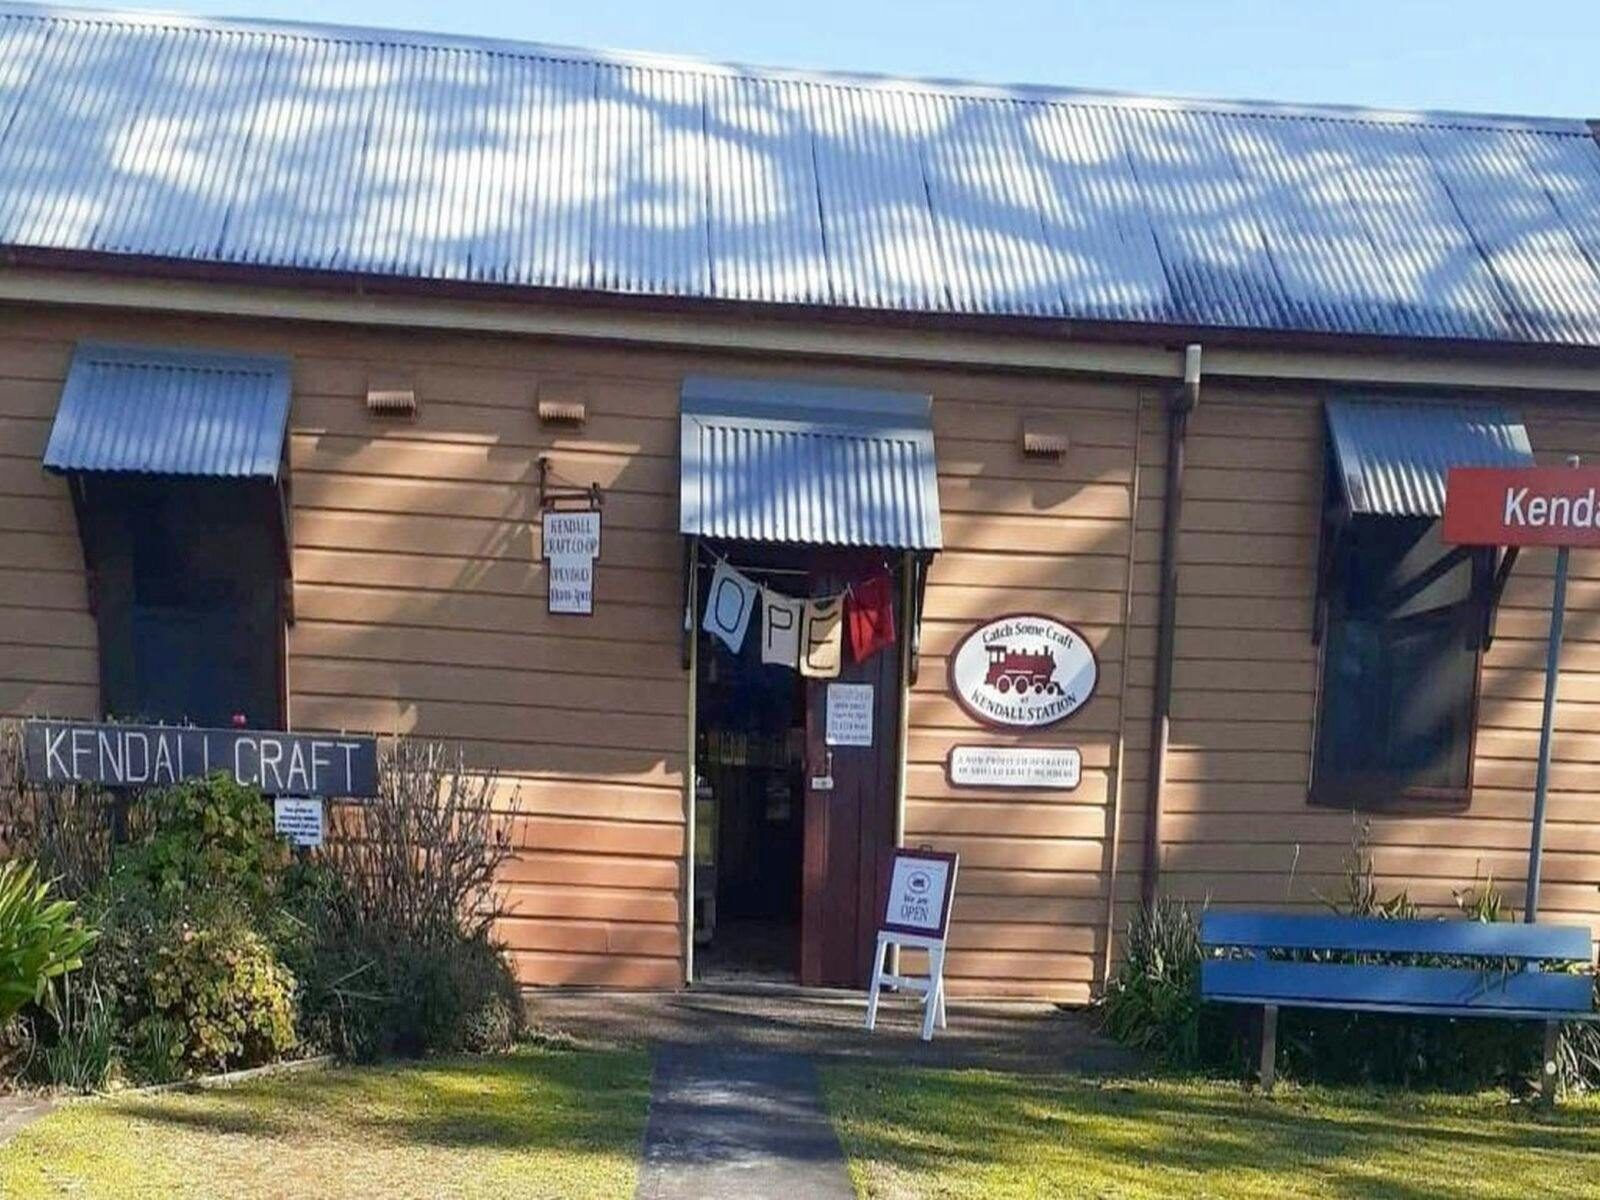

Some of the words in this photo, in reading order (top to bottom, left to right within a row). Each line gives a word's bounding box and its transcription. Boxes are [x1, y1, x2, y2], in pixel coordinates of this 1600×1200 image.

[1504, 487, 1600, 527] Kend
[550, 519, 592, 533] KENDALL
[982, 623, 1014, 644] Catch
[1015, 621, 1045, 636] Some
[1046, 626, 1074, 649] Craft
[971, 688, 1026, 720] KENDALL
[1027, 691, 1078, 721] STATION
[234, 737, 361, 792] CRAFT
[901, 905, 929, 921] OPEN
